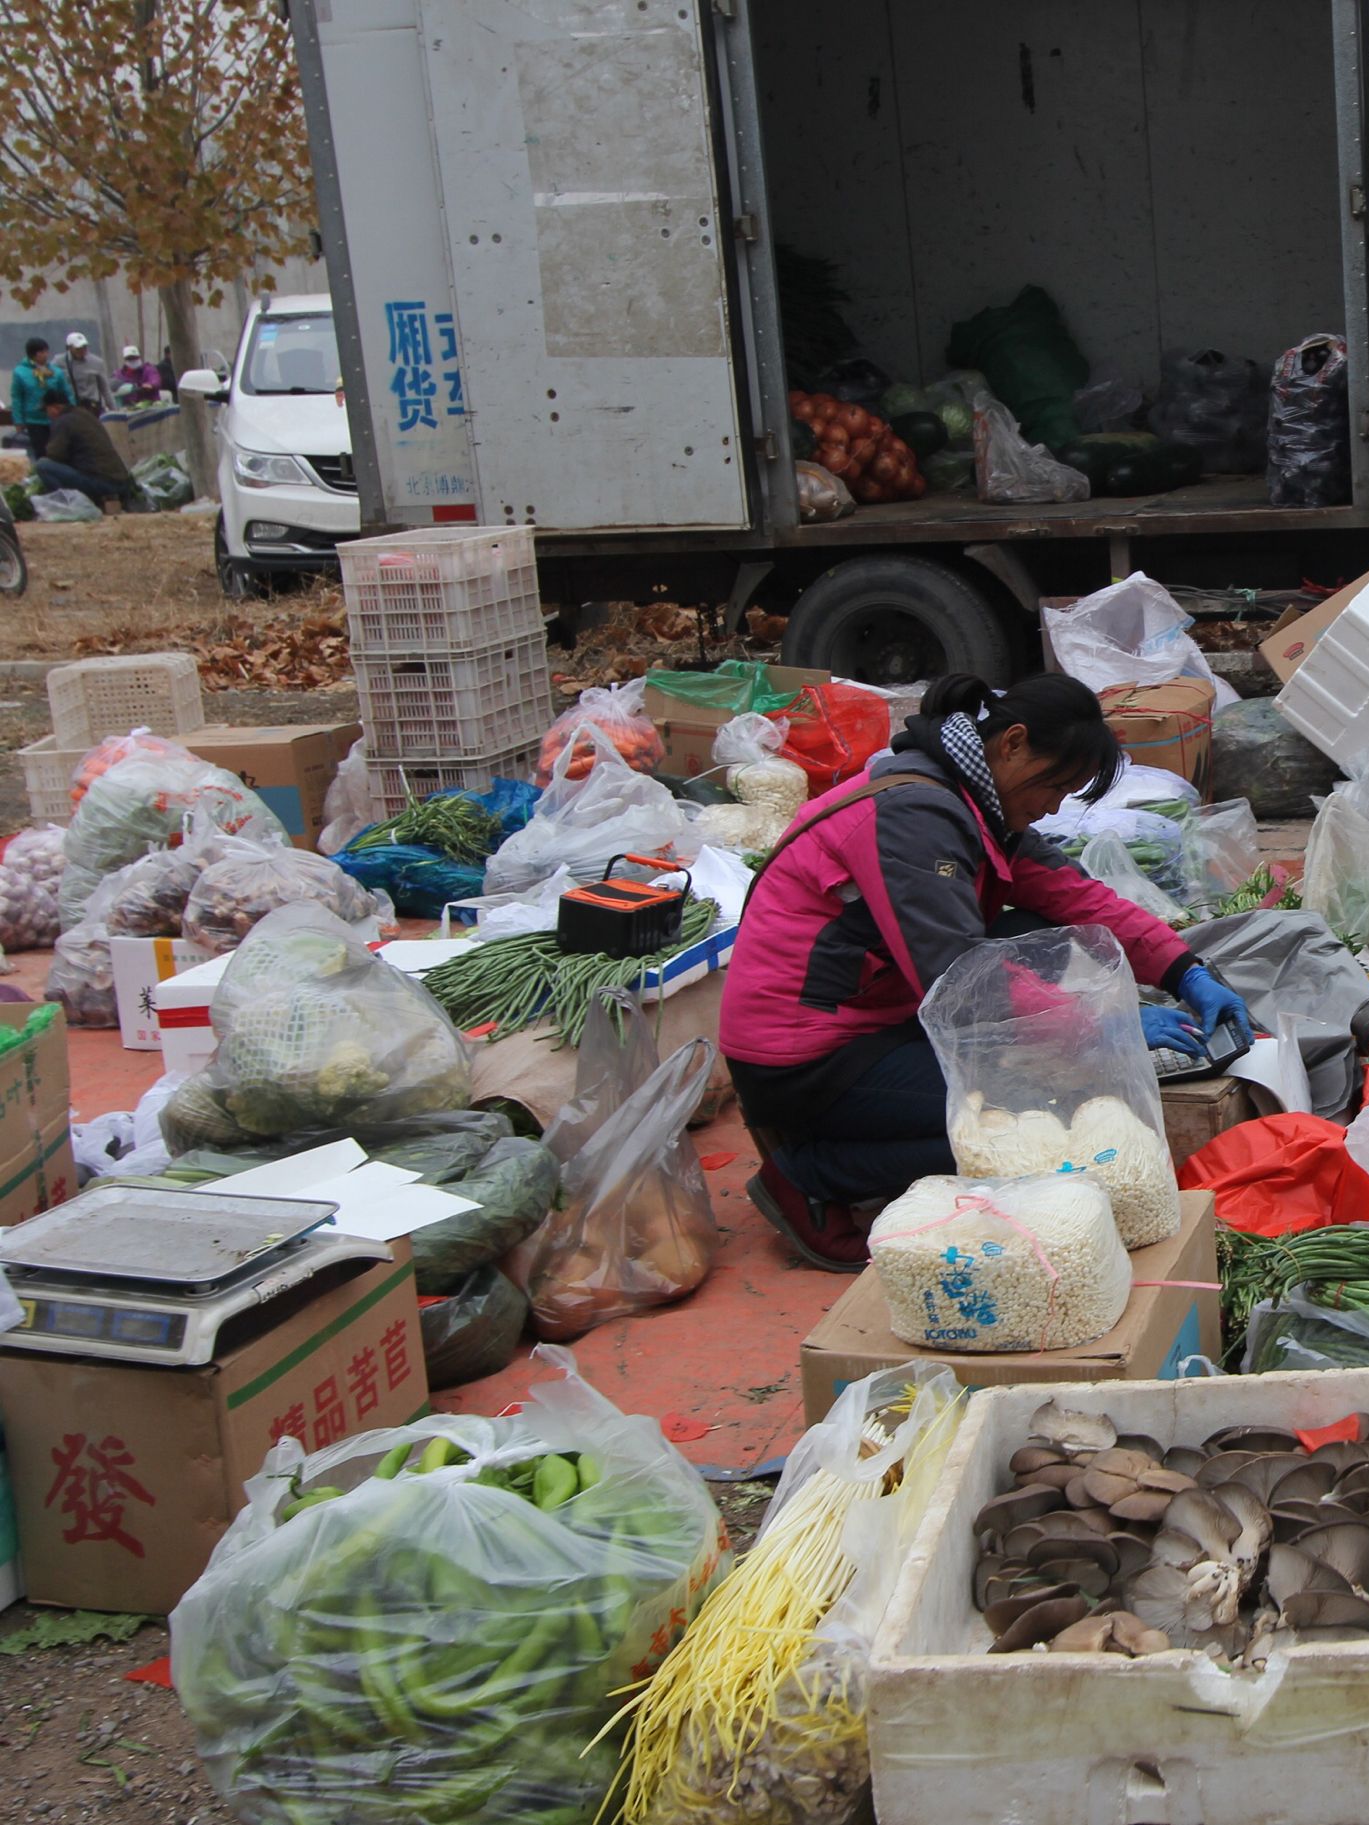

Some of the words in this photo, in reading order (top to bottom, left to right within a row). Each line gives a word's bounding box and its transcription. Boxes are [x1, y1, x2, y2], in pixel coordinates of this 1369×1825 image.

[268, 1319, 411, 1456] 精品苦苣
[45, 1433, 156, 1559] 發
